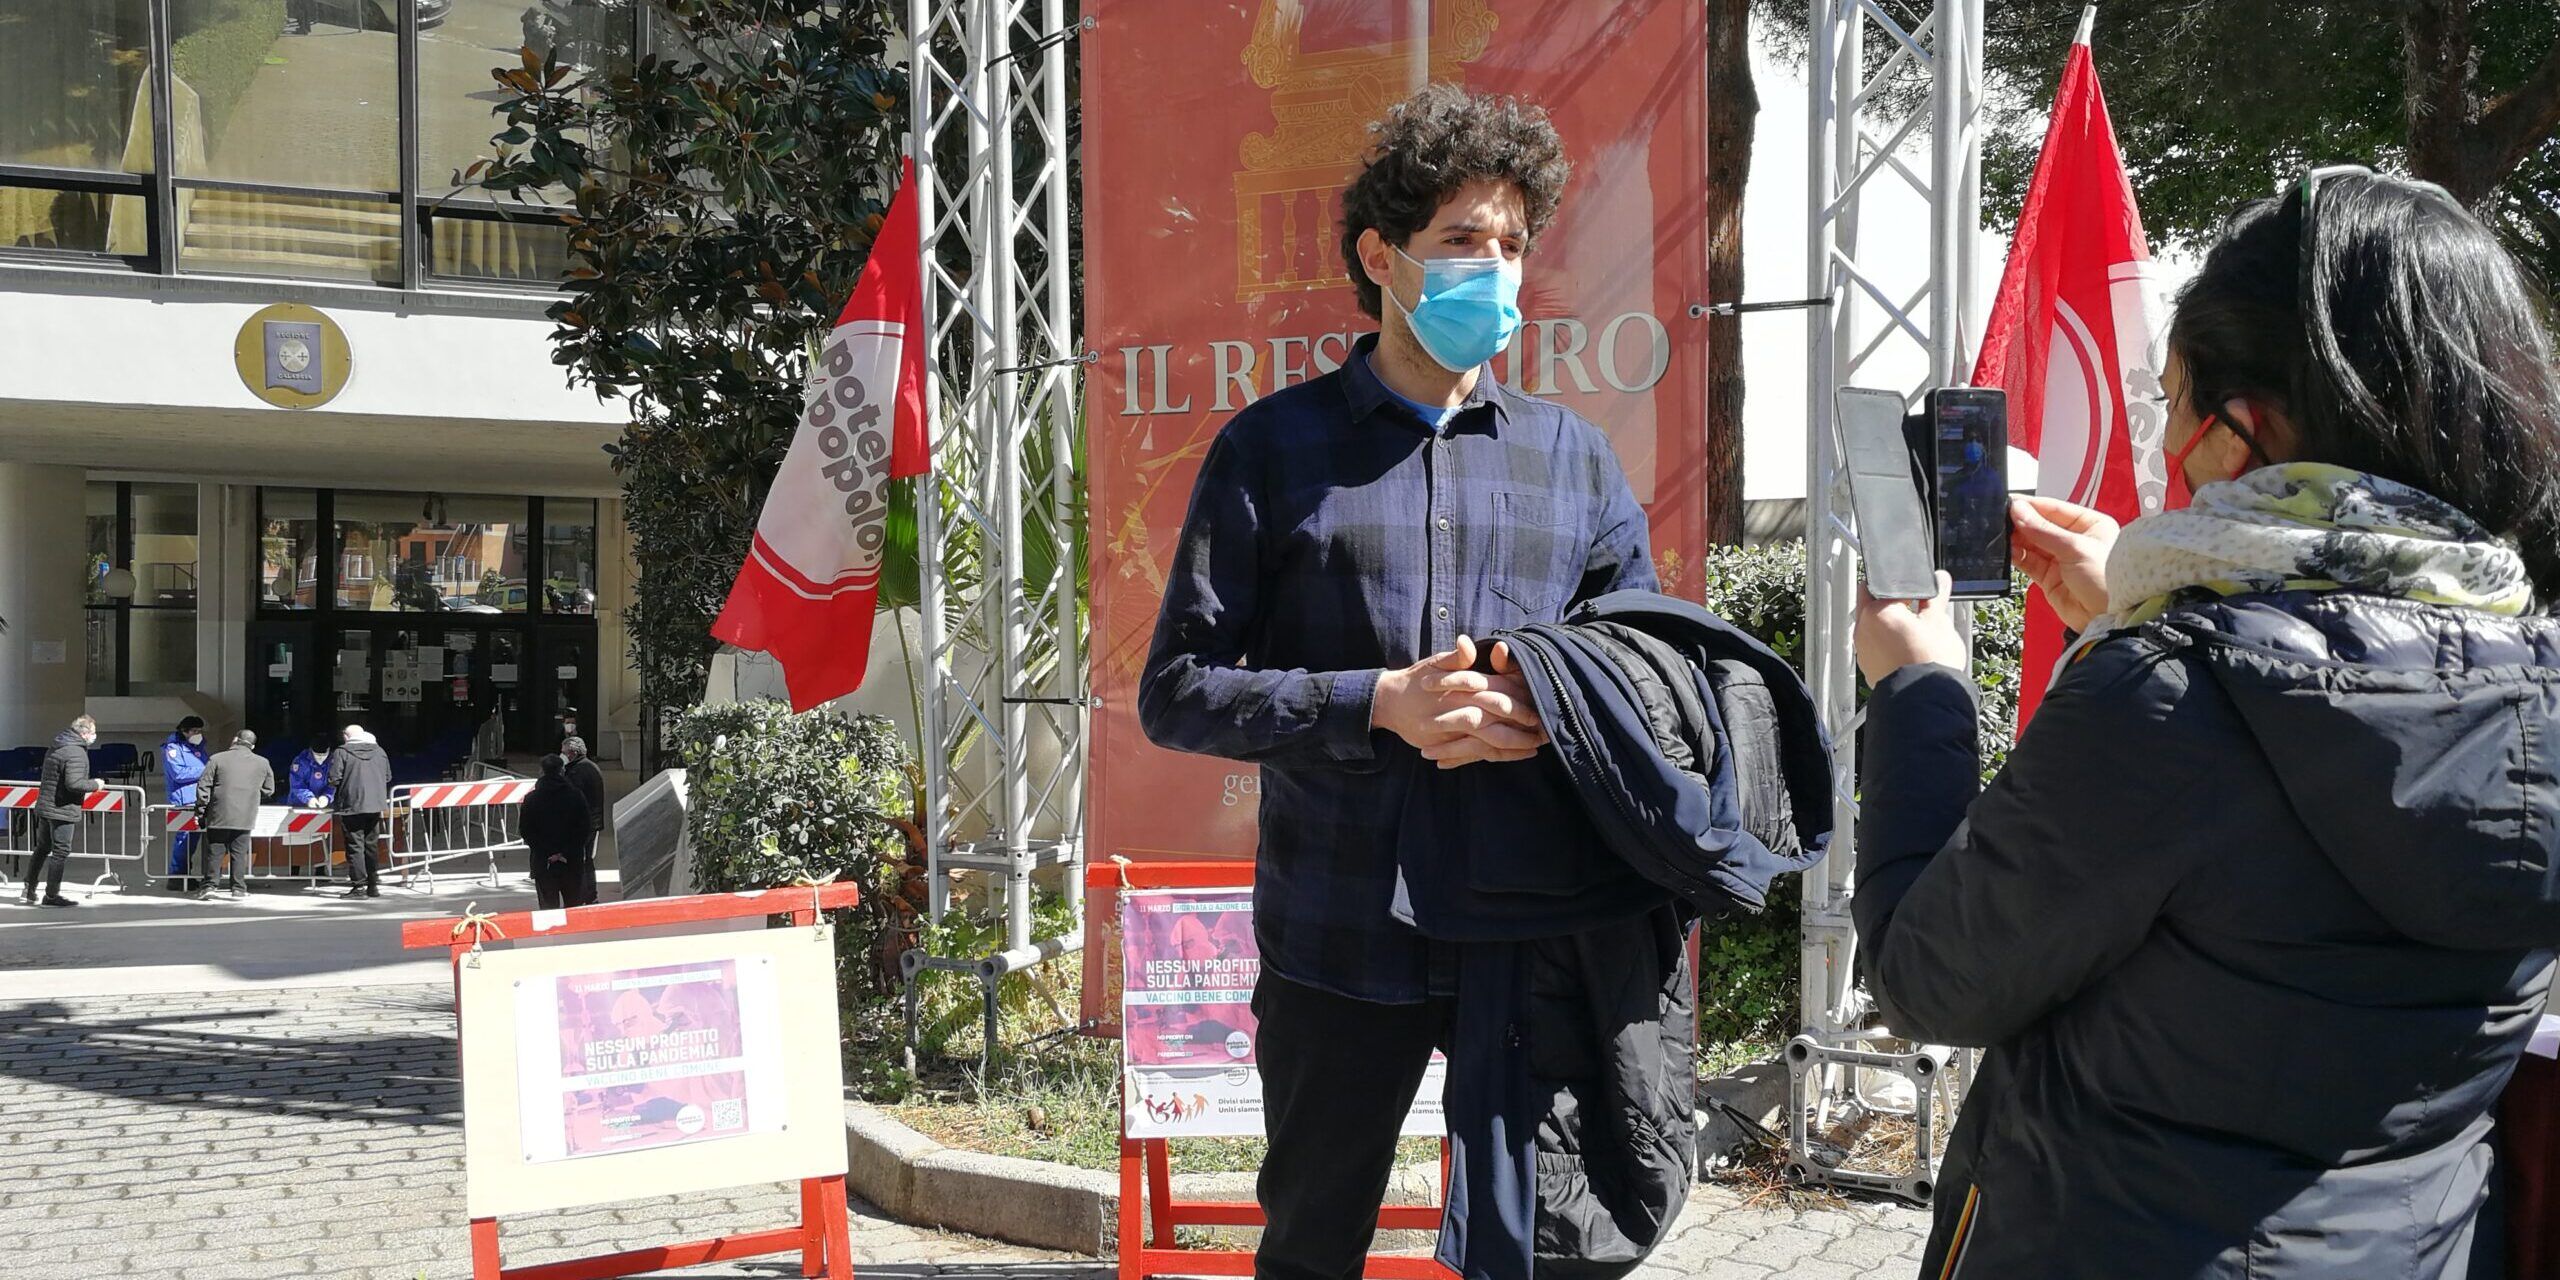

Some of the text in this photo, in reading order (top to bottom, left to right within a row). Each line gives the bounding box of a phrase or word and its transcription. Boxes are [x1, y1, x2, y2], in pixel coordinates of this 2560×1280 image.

[1119, 345, 1191, 415] IL
[1145, 958, 1260, 974] NESSUN PROFITT
[1147, 974, 1191, 988] SULLA
[1146, 991, 1192, 1003] VACCINO
[1195, 991, 1222, 1002] BENE
[584, 1029, 718, 1055] NESSUN PROFITTO
[586, 1043, 720, 1071] SULLA PANDEMIA!
[586, 1071, 636, 1086] VACCINO
[674, 1061, 721, 1078] COMUNE
